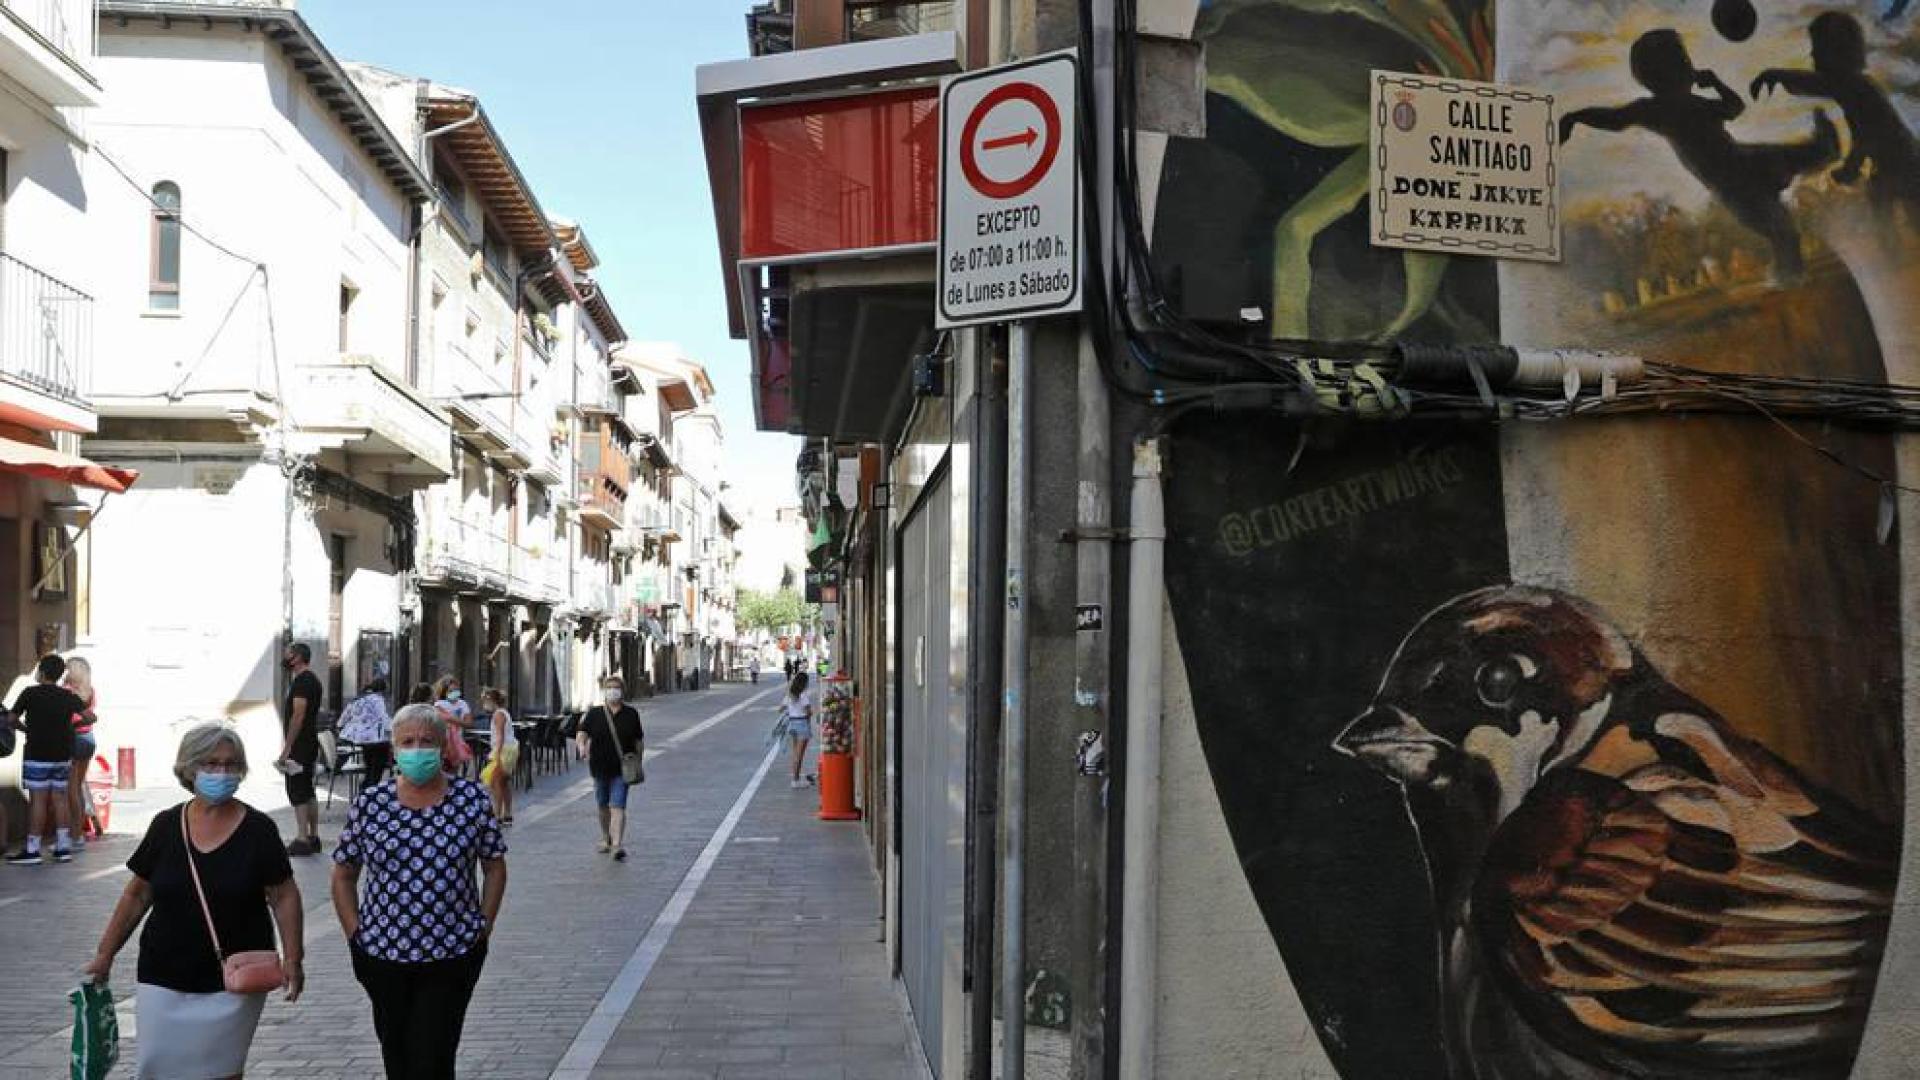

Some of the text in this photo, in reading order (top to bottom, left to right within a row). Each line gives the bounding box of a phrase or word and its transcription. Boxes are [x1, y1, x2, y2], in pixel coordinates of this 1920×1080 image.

[1448, 100, 1513, 132] CALLE
[1429, 135, 1531, 171] SANTIAGO
[1392, 176, 1543, 206] DONE JAKVE
[977, 205, 1040, 235] EXCEPTO
[1409, 209, 1527, 235] KARRIKA
[950, 235, 1067, 273] de 07:00 a 11:00 h.
[948, 269, 1069, 305] de Lunes a Sábado
